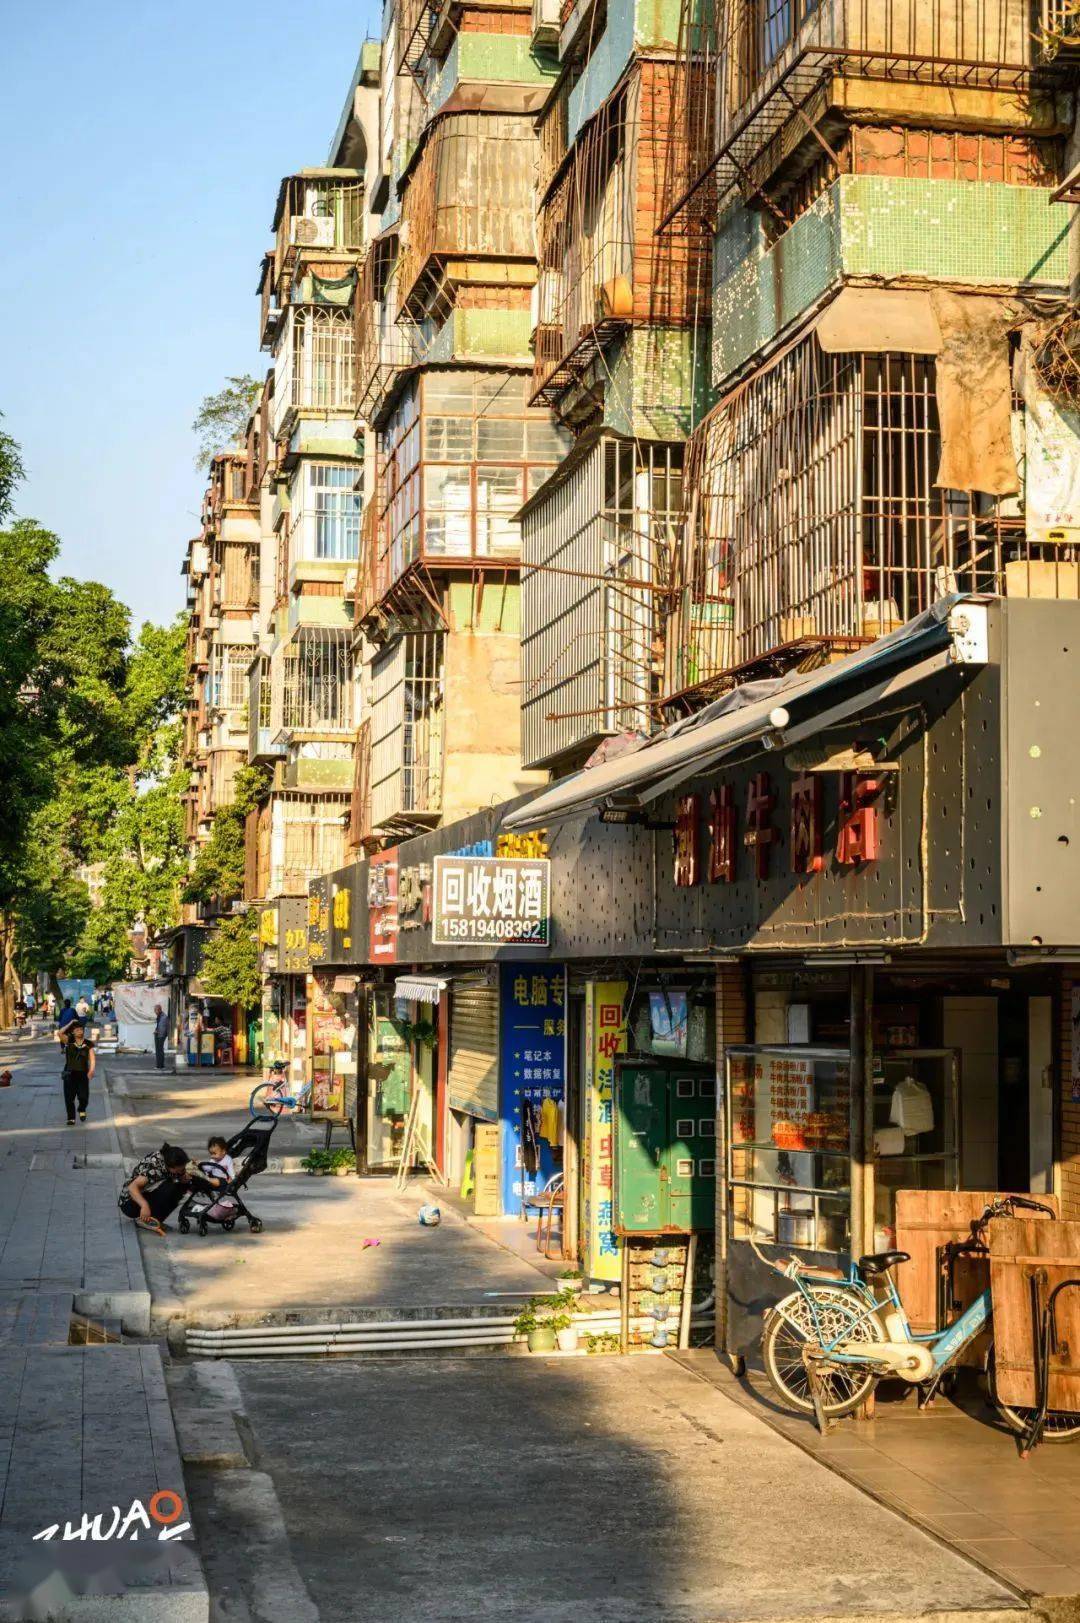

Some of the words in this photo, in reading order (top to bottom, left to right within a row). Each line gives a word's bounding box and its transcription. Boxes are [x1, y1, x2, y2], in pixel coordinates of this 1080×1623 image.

[442, 865, 542, 919] 回收烟酒
[441, 919, 541, 939] 15819408392
[524, 1050, 552, 1062] 笔记本
[523, 1068, 561, 1080] 数据恢复
